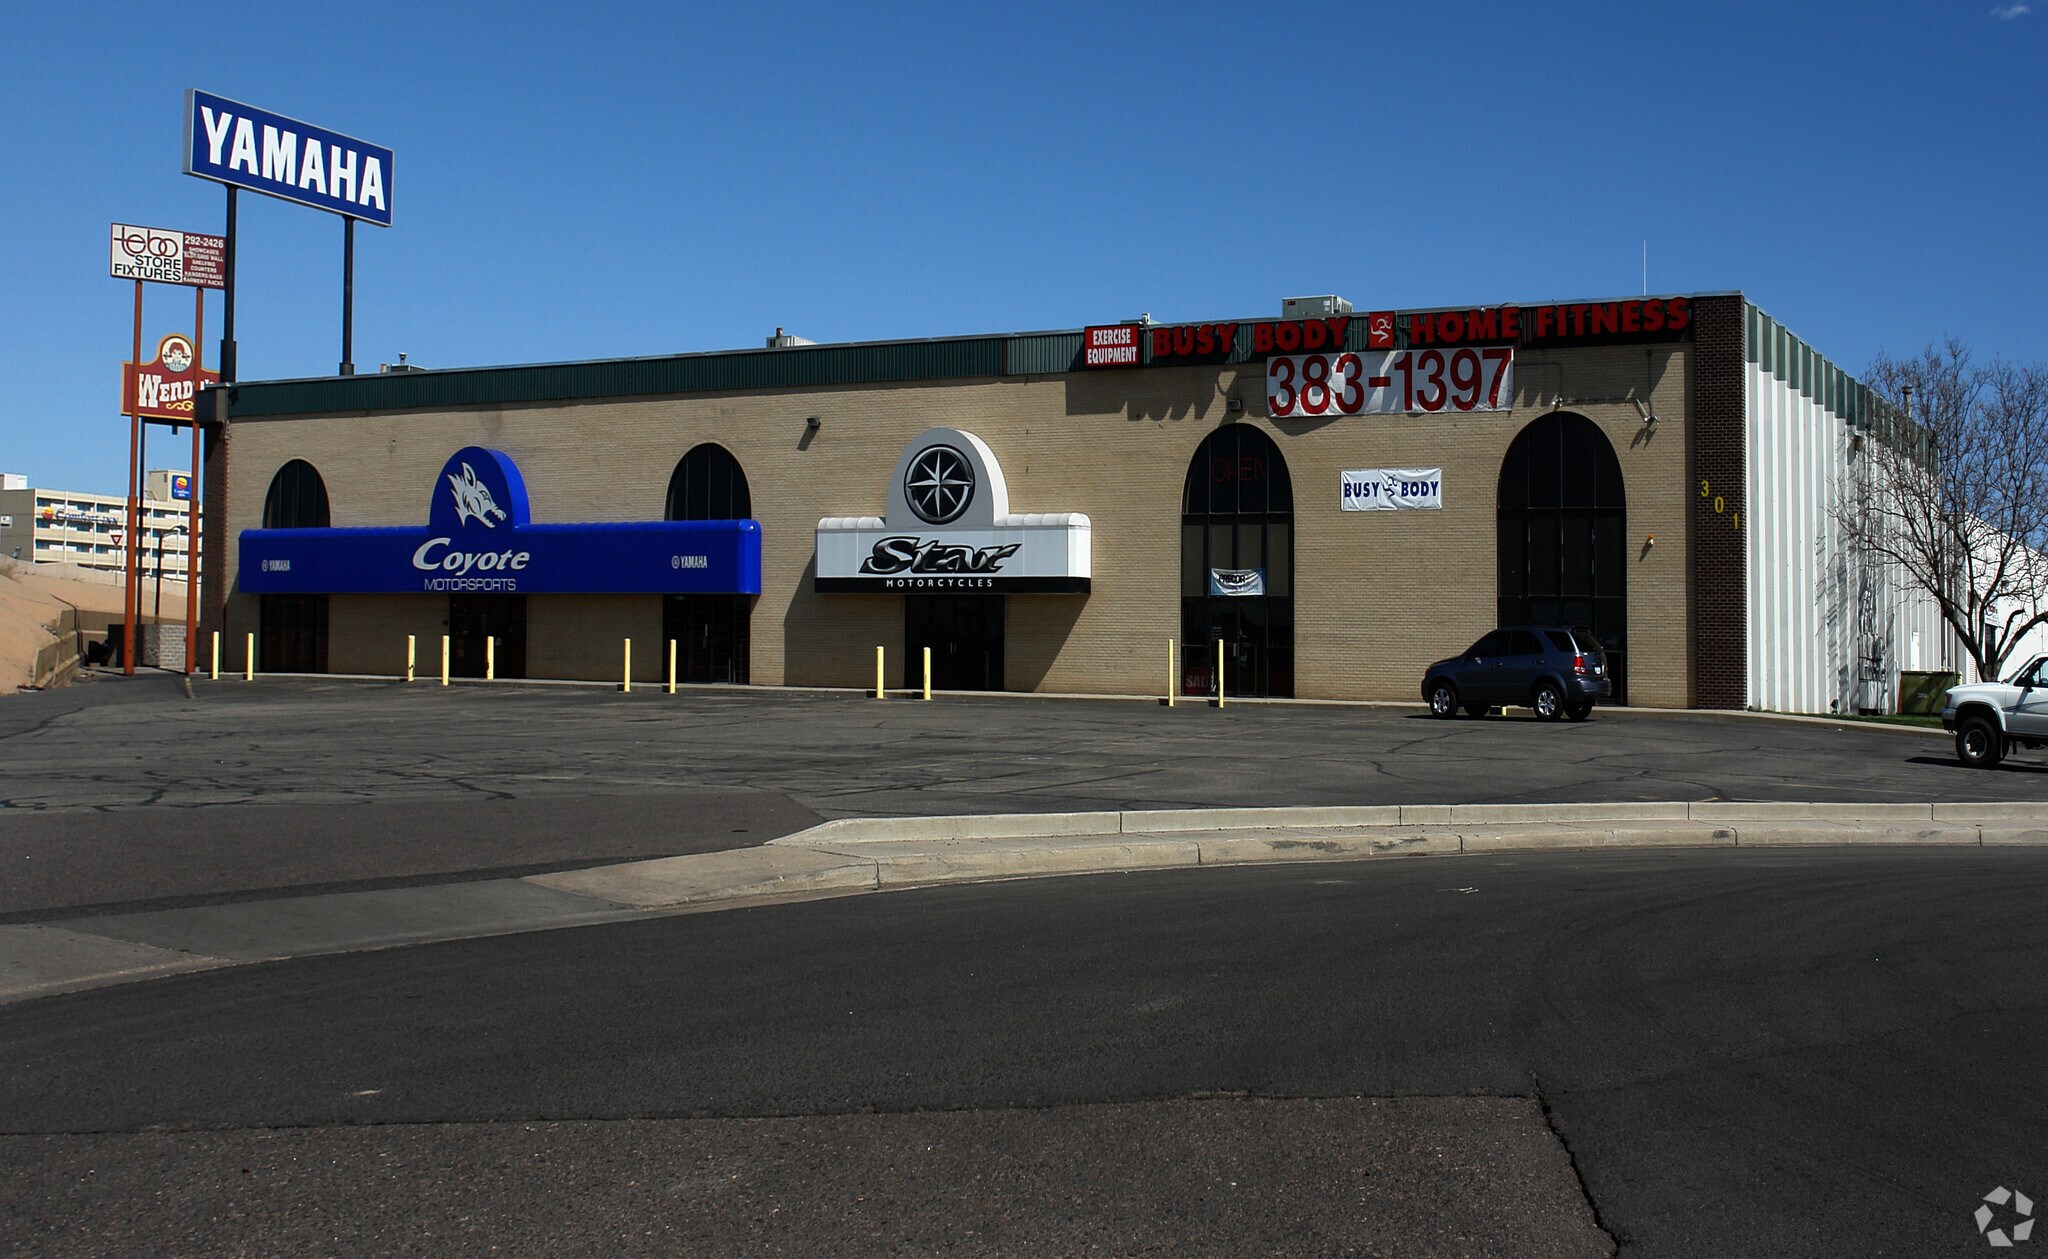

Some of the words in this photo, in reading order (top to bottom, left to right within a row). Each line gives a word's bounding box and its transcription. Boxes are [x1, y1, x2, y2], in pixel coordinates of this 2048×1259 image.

[201, 105, 385, 211] YAMAHA
[114, 227, 178, 257] tebo
[185, 235, 224, 248] 292-2426
[135, 255, 181, 270] STORE
[114, 263, 181, 281] FIXTURES
[1152, 323, 1239, 357] BUSY
[1254, 316, 1351, 353] BODY
[1411, 306, 1519, 345] HOME
[1536, 297, 1690, 340] FITNESS
[1093, 328, 1131, 346] EXERCISE
[1087, 346, 1137, 364] EQUIPMENT
[1268, 348, 1511, 416] 383-1397
[1212, 456, 1266, 483] OPEN
[1344, 482, 1380, 498] BUSY
[1401, 481, 1439, 497] BODY
[412, 537, 530, 576] Coyote
[680, 555, 708, 569] YAMAHA
[858, 536, 1022, 574] Star
[268, 559, 291, 572] YAMAHA
[424, 578, 516, 591] MOTORSPORTS
[886, 579, 993, 588] MOTORCYCLES
[1219, 574, 1246, 584] PRECOR
